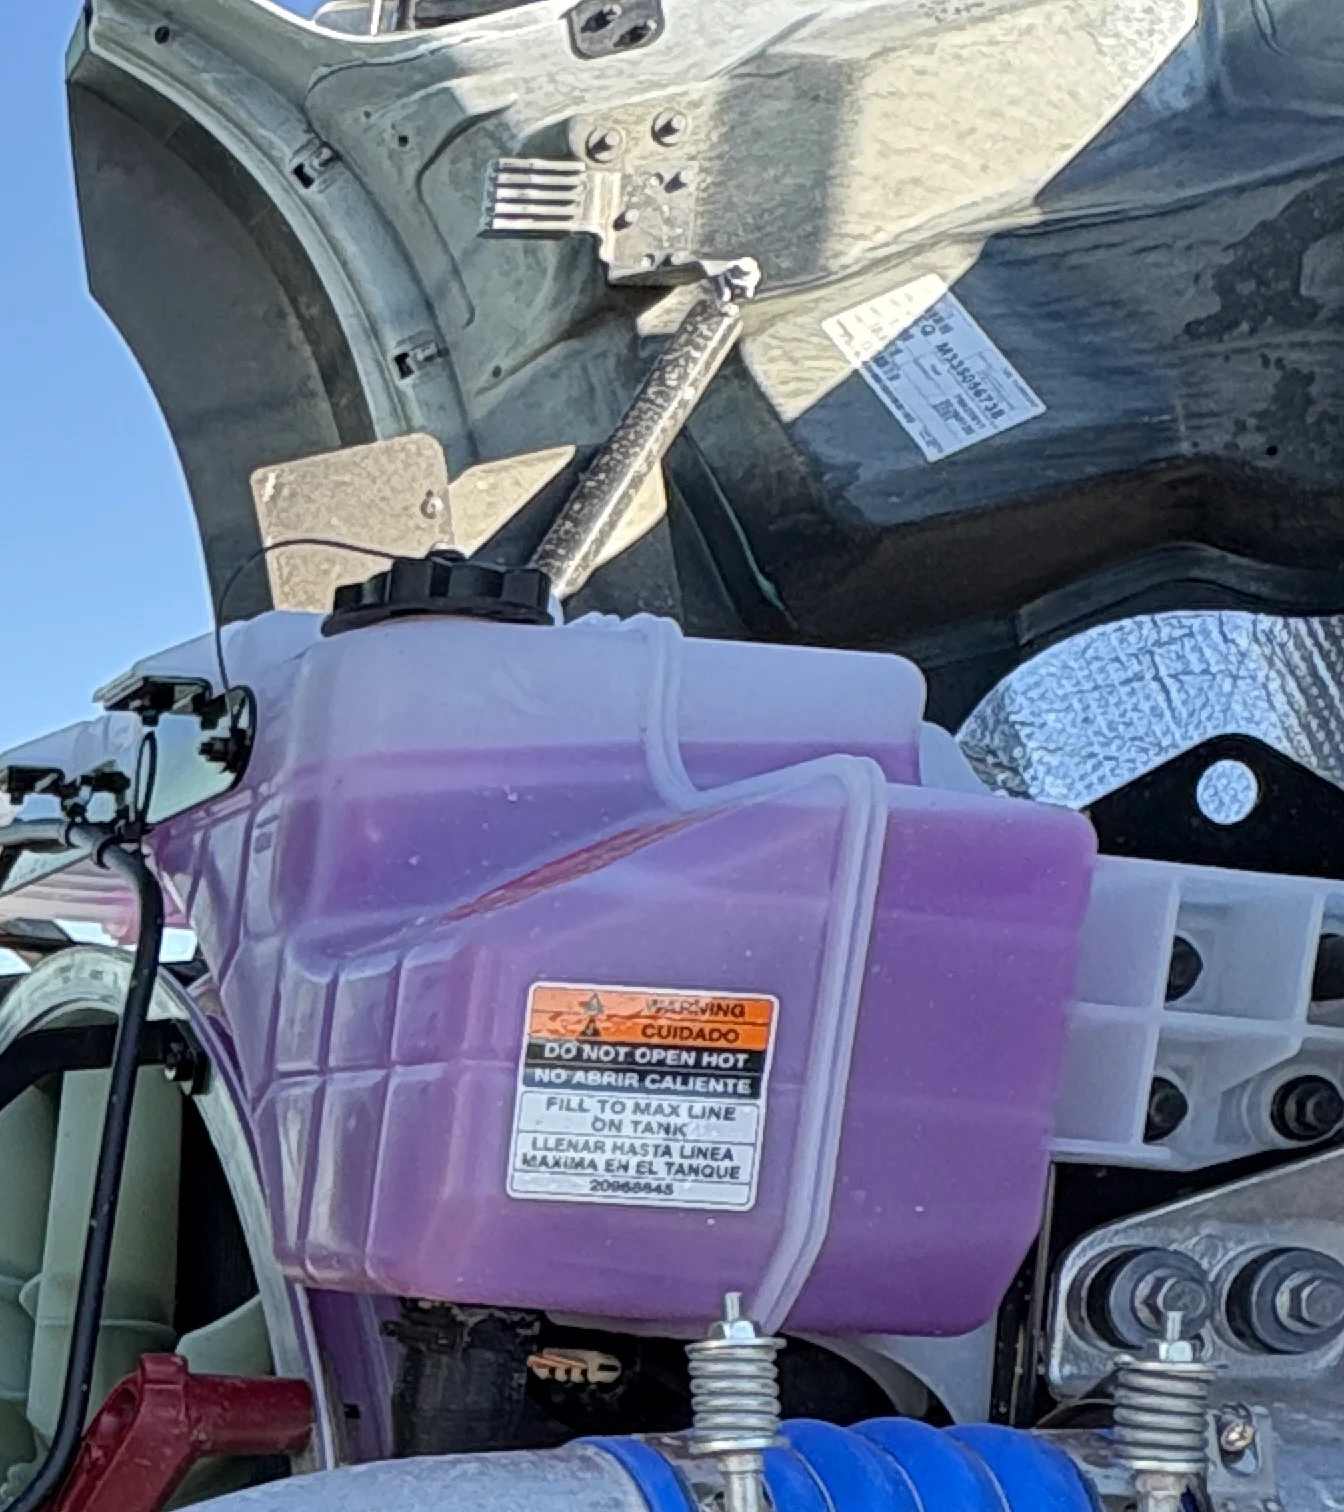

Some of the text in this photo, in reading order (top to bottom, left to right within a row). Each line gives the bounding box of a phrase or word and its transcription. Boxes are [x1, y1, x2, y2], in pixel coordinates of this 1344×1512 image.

[641, 1024, 740, 1044] CUIDADO
[544, 1042, 750, 1069] DO NOT OPEN HOT
[534, 1067, 753, 1095] NO ABRIR CALIENTE
[545, 1096, 737, 1122] FILL TO MAX LINE
[591, 1116, 689, 1138] ON TANK
[531, 1136, 735, 1163] LLENAR HASTA LINEA
[520, 1152, 742, 1180] MAXIMA EN EL TANQUE
